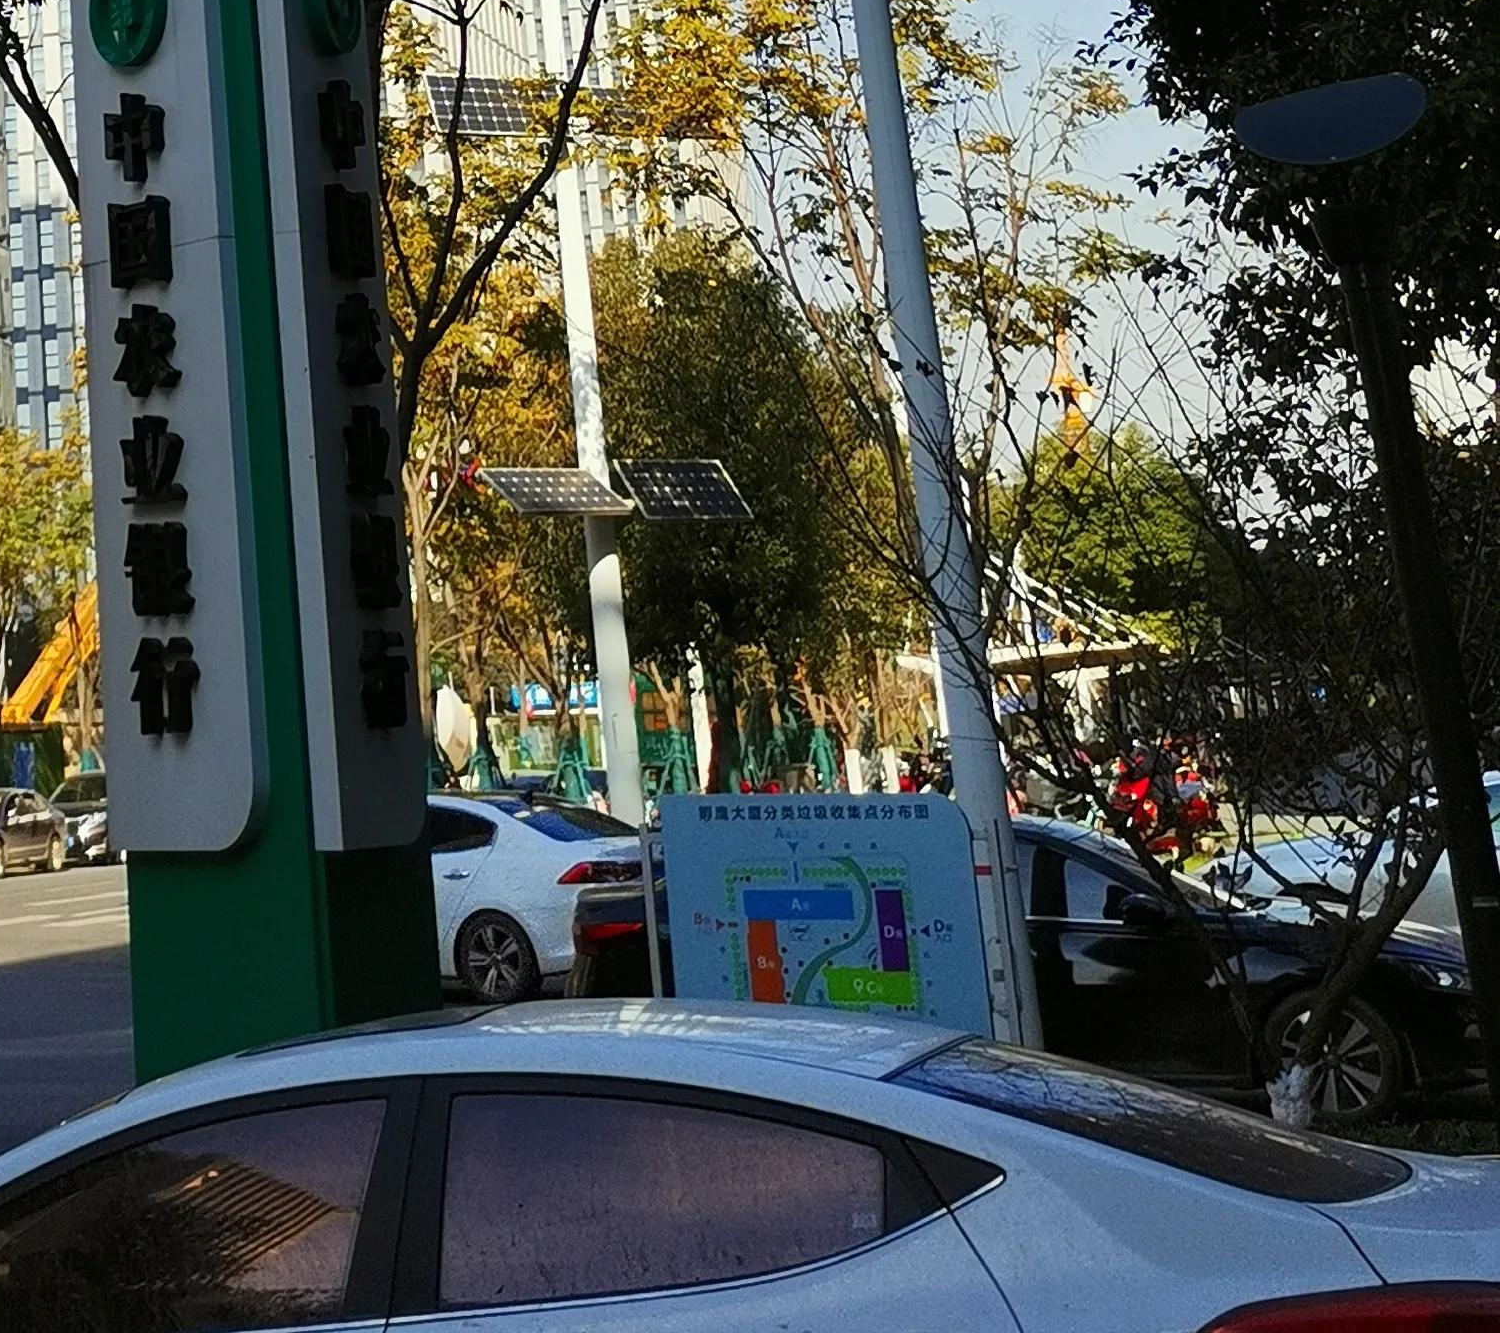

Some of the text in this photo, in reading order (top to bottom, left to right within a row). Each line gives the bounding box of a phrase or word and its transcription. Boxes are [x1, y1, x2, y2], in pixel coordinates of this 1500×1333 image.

[103, 92, 201, 736] 中国农业银行
